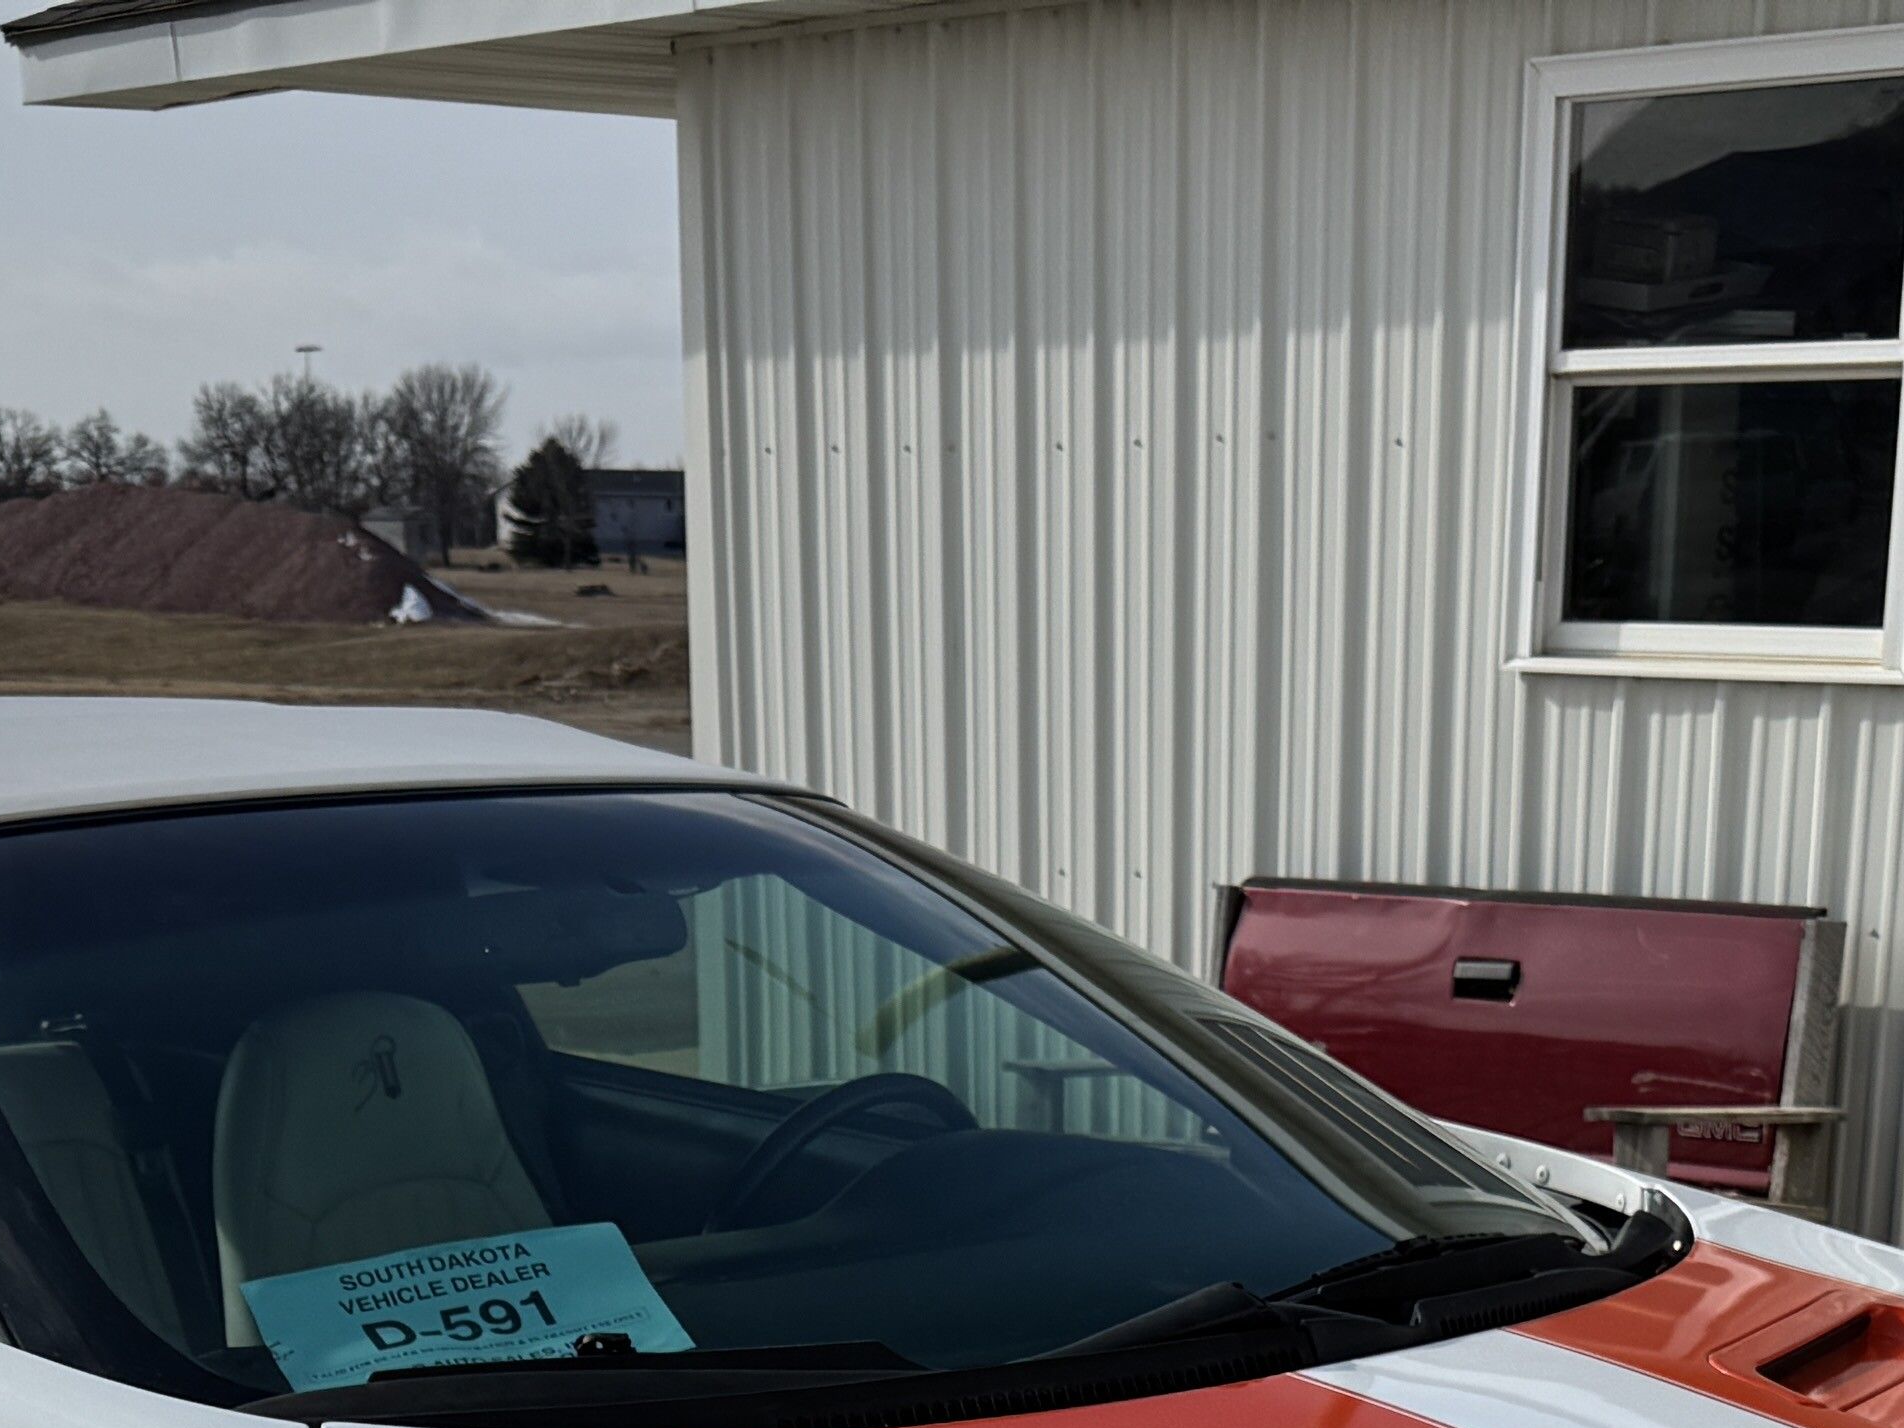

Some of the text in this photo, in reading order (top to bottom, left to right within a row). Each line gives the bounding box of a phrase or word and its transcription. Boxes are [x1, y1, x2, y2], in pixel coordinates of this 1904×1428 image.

[339, 1242, 532, 1292] SOUTH DAKOTA
[339, 1261, 552, 1316] VEHICLE DEALER
[361, 1289, 558, 1351] D-591
